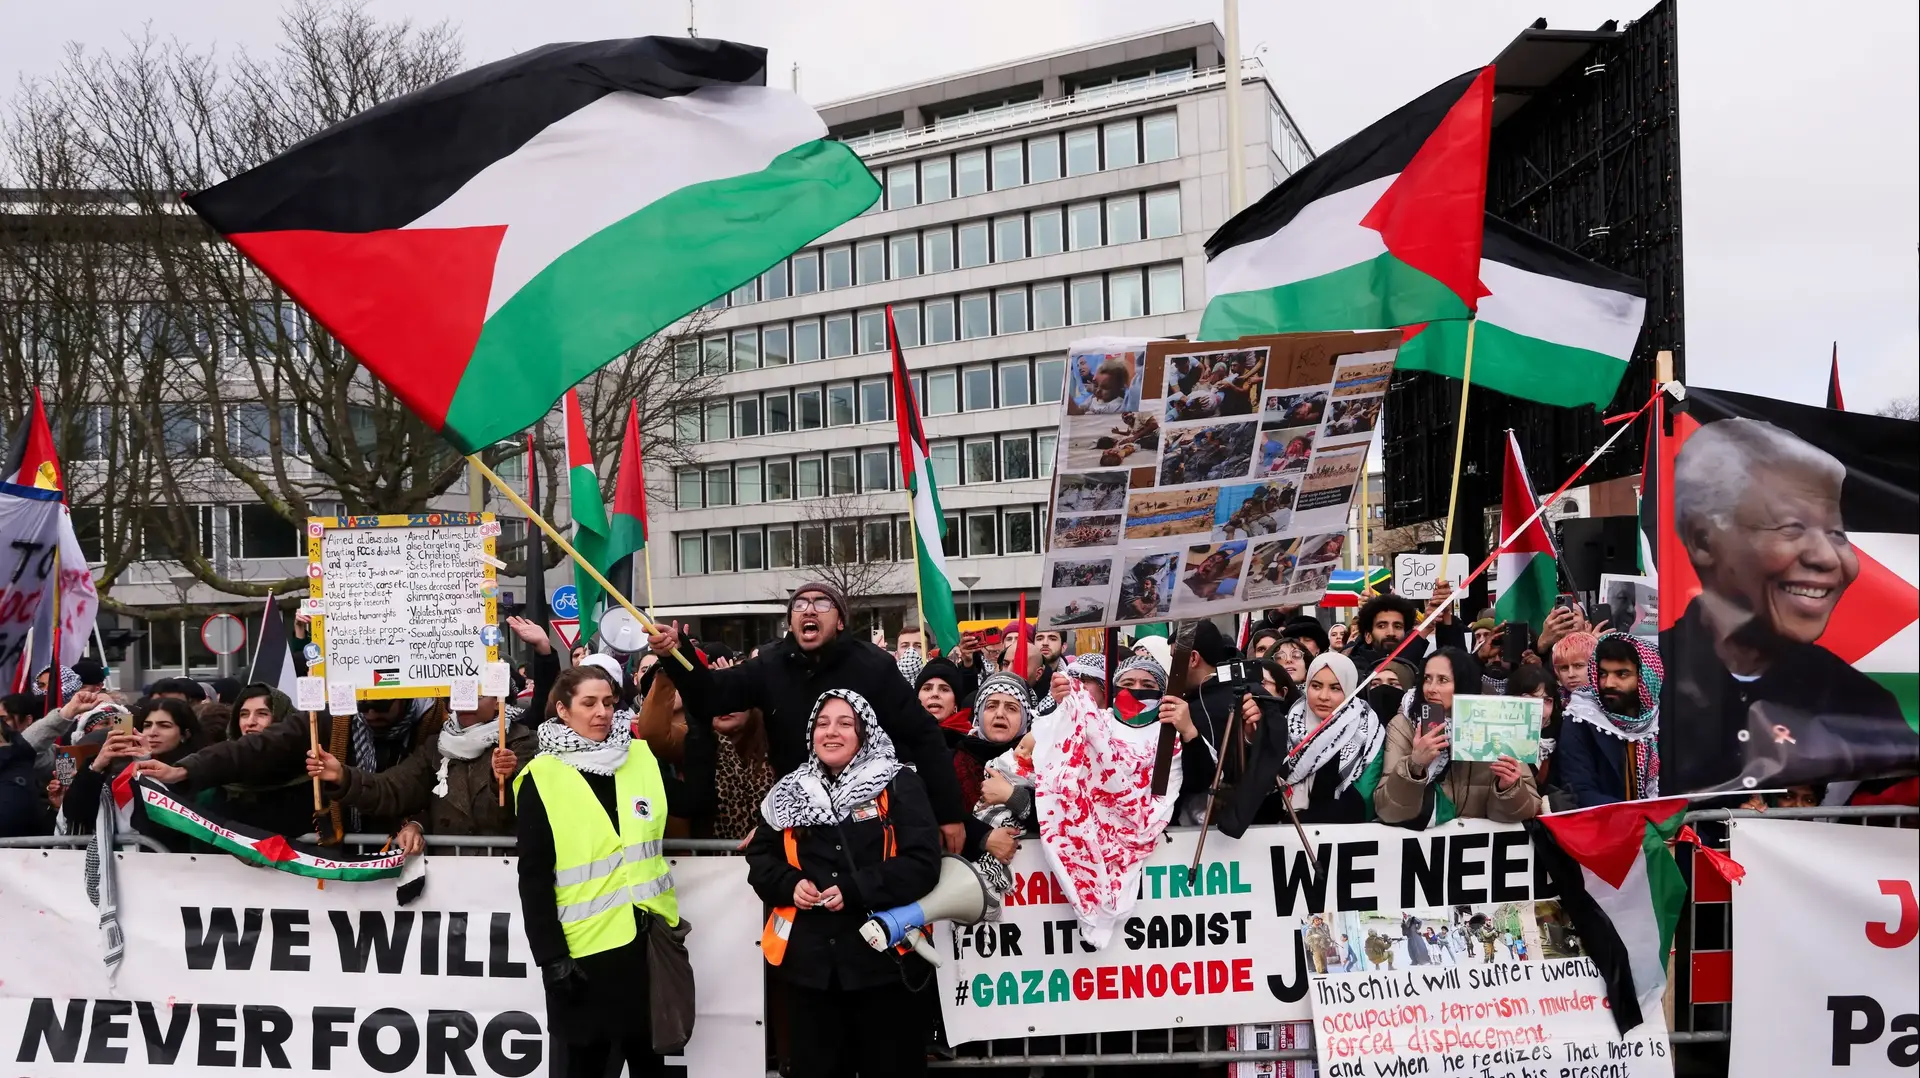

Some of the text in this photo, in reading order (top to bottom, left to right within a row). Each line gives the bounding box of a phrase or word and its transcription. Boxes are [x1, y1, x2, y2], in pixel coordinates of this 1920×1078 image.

[338, 515, 379, 528] NAZIS
[407, 530, 430, 541] Aimed
[464, 528, 478, 539] but
[480, 523, 501, 536] CNN
[406, 540, 482, 552] also targeting Jews
[406, 550, 460, 560] & Christians
[329, 558, 341, 569] and
[409, 561, 428, 571] Sets
[358, 569, 366, 578] to
[406, 569, 485, 581] ian owned properties
[410, 578, 478, 592] Uses deceased for
[329, 590, 346, 599] Used
[302, 599, 324, 608] NOS
[472, 626, 481, 635] &
[455, 640, 474, 655] rape
[332, 652, 360, 671] Rape
[364, 654, 400, 664] women
[428, 652, 457, 660] women
[408, 656, 479, 680] CHILDREN &
[147, 790, 237, 841] PALESTINE
[1142, 861, 1252, 899] TRIAL
[1270, 840, 1379, 917] WE
[180, 906, 527, 979] WE WILL
[953, 922, 1023, 961] FOR
[1123, 910, 1252, 951] SADIST
[955, 958, 1254, 1008] #GAZAGENOCIDE
[1312, 976, 1355, 1006] This
[1358, 971, 1421, 1001] child
[1422, 967, 1461, 993] will
[1469, 962, 1534, 990] suffer
[1539, 989, 1599, 1017] murder
[16, 997, 294, 1069] NEVER
[1327, 1029, 1395, 1062] forced
[1329, 1055, 1366, 1078] and
[1442, 1053, 1465, 1074] he
[1473, 1044, 1553, 1069] realizes
[1649, 1037, 1666, 1058] is
